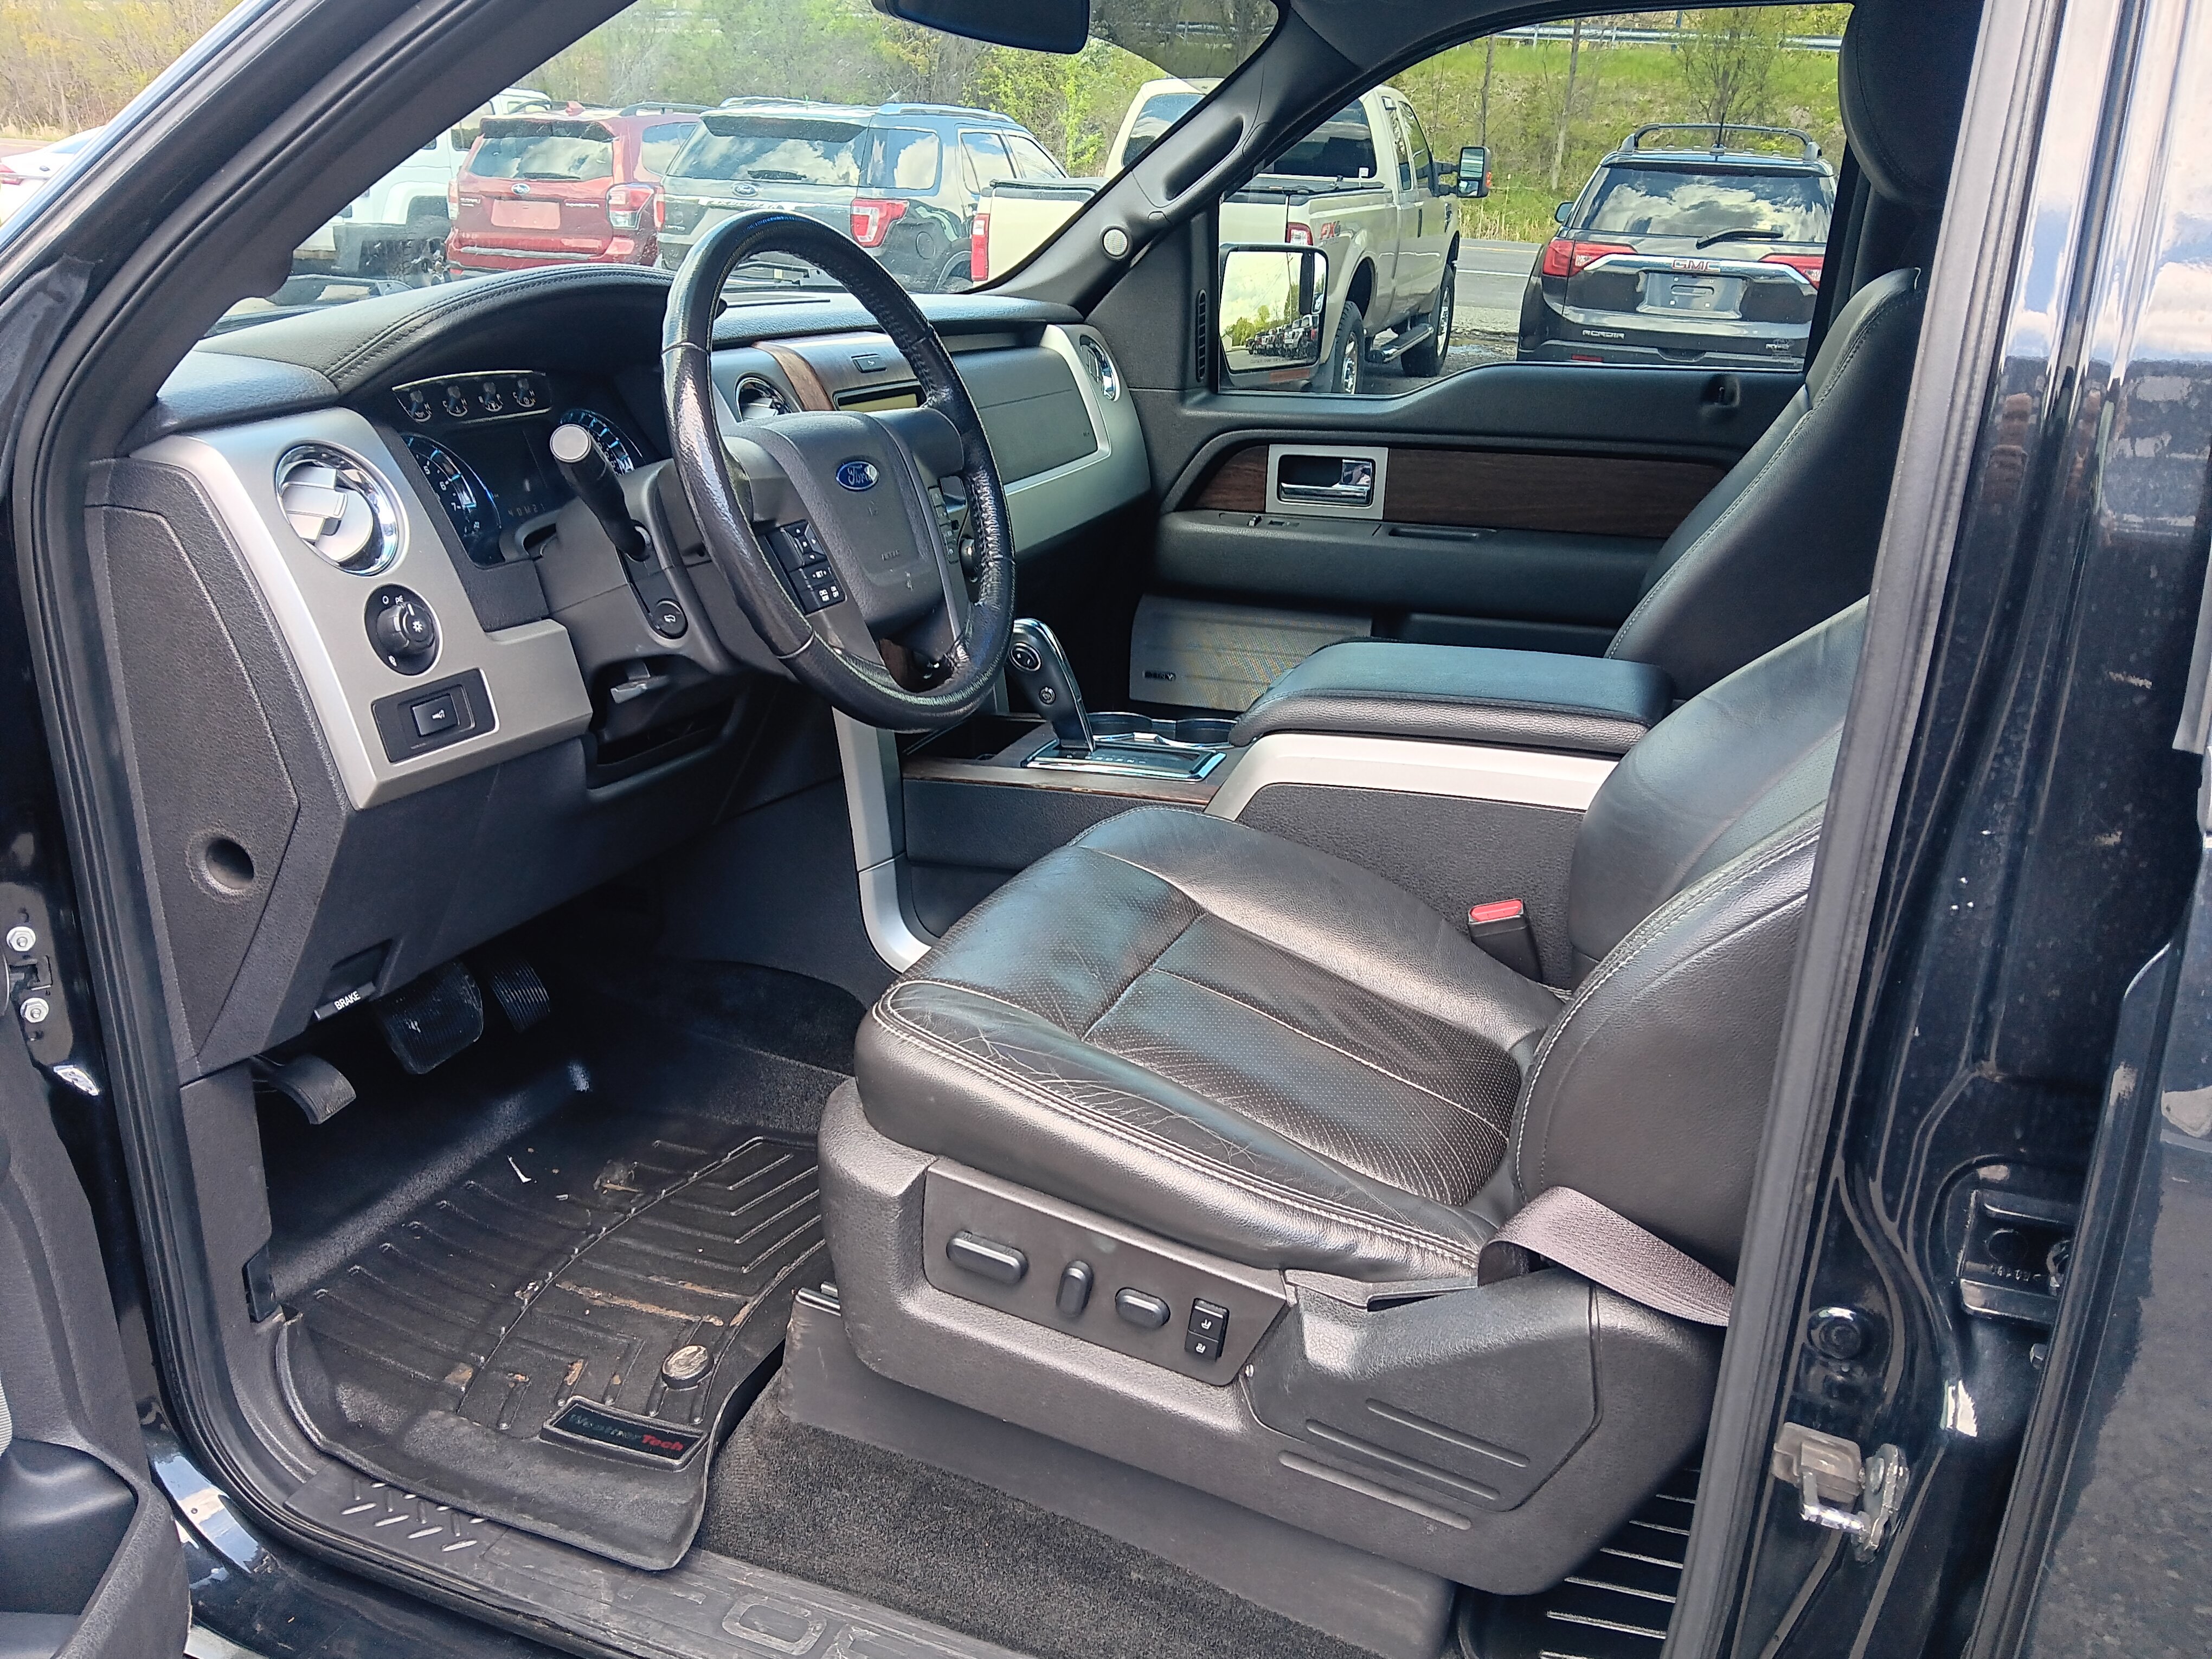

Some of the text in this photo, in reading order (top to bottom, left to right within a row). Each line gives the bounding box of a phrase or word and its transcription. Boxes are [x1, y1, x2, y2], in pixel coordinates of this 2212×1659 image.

[1320, 221, 1341, 240] FX4
[1671, 259, 1721, 272] GMC
[1582, 329, 1625, 340] ACADIA
[423, 465, 430, 475] 5
[847, 464, 872, 485] Ford
[439, 481, 447, 491] 6
[451, 502, 456, 512] 7
[333, 990, 361, 1011] BRAKE
